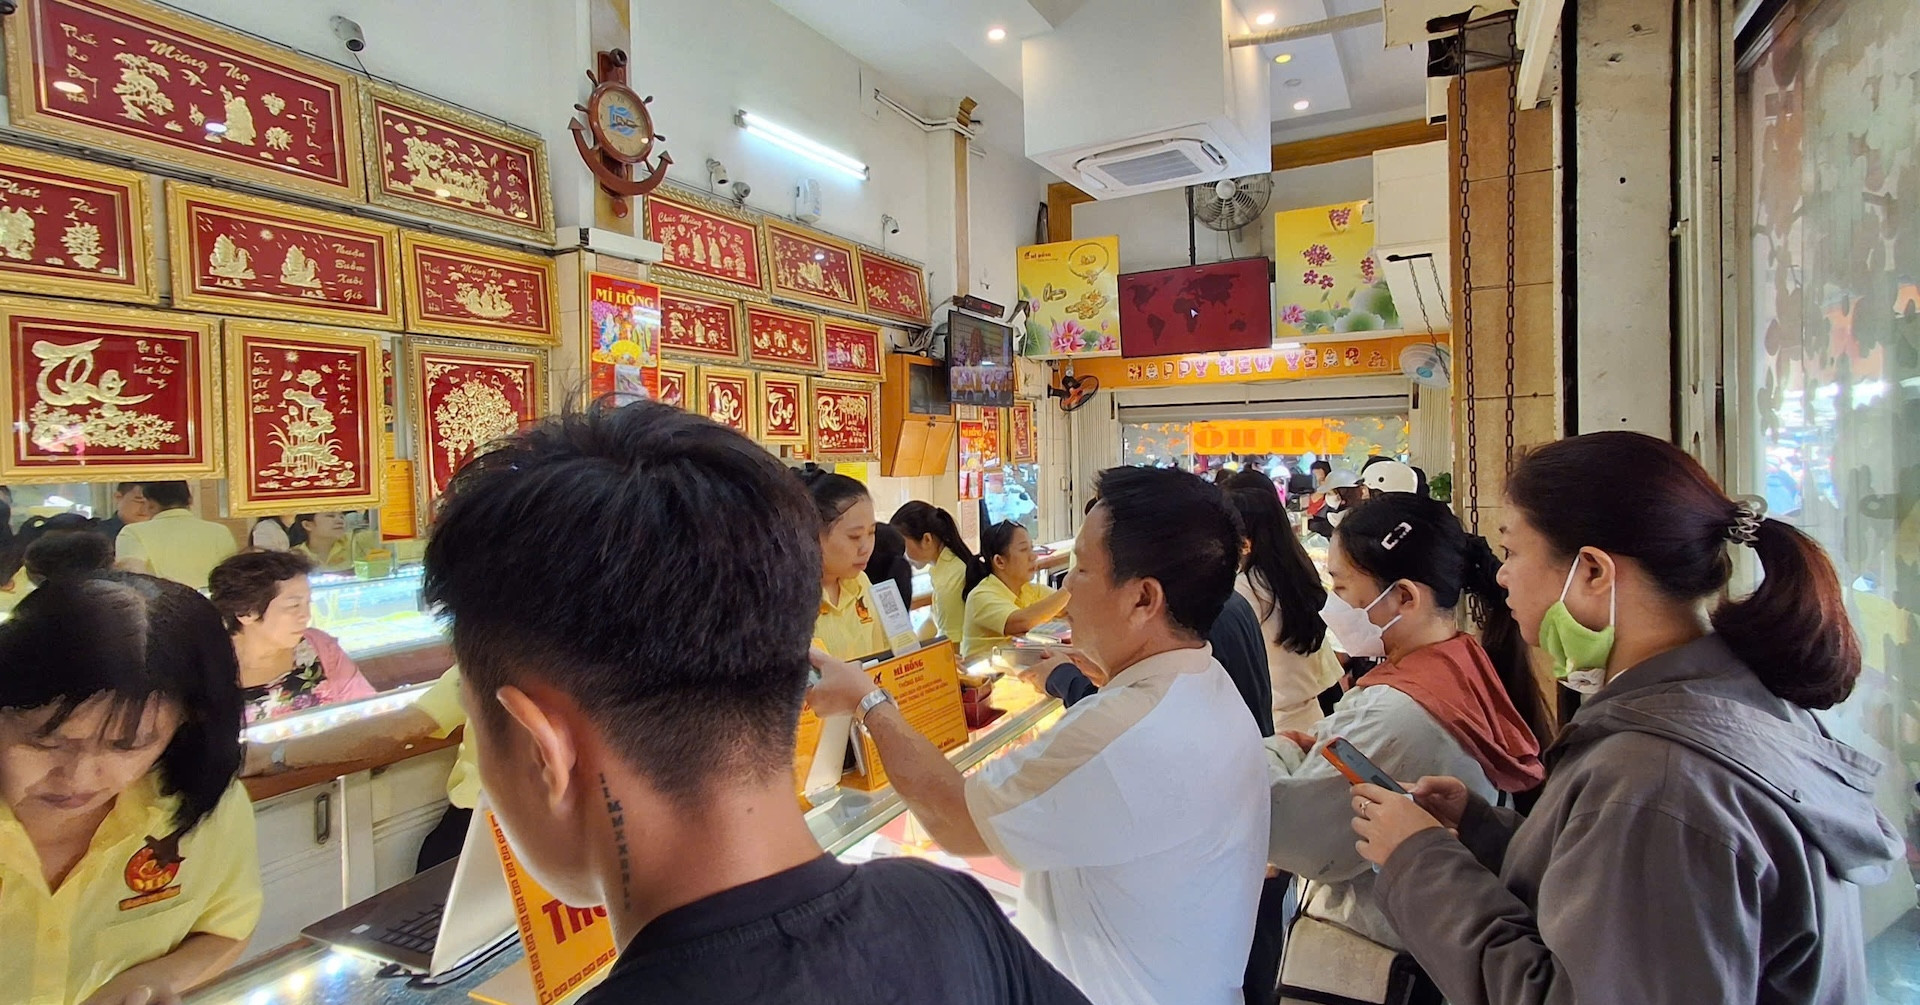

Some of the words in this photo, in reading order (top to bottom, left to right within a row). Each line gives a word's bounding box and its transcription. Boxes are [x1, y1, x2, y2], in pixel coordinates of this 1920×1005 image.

[145, 39, 208, 74] Mừng
[219, 61, 251, 85] Thọ
[658, 211, 676, 223] Chúc
[680, 214, 702, 229] Mừng
[332, 243, 366, 258] Thuận
[335, 259, 366, 272] Buồm
[337, 273, 364, 285] Xuôi
[343, 289, 363, 301] Gió
[615, 288, 654, 308] HỒNG
[1128, 359, 1208, 380] HAPPY
[1217, 355, 1274, 376] NEW
[1285, 346, 1360, 372] YEAR
